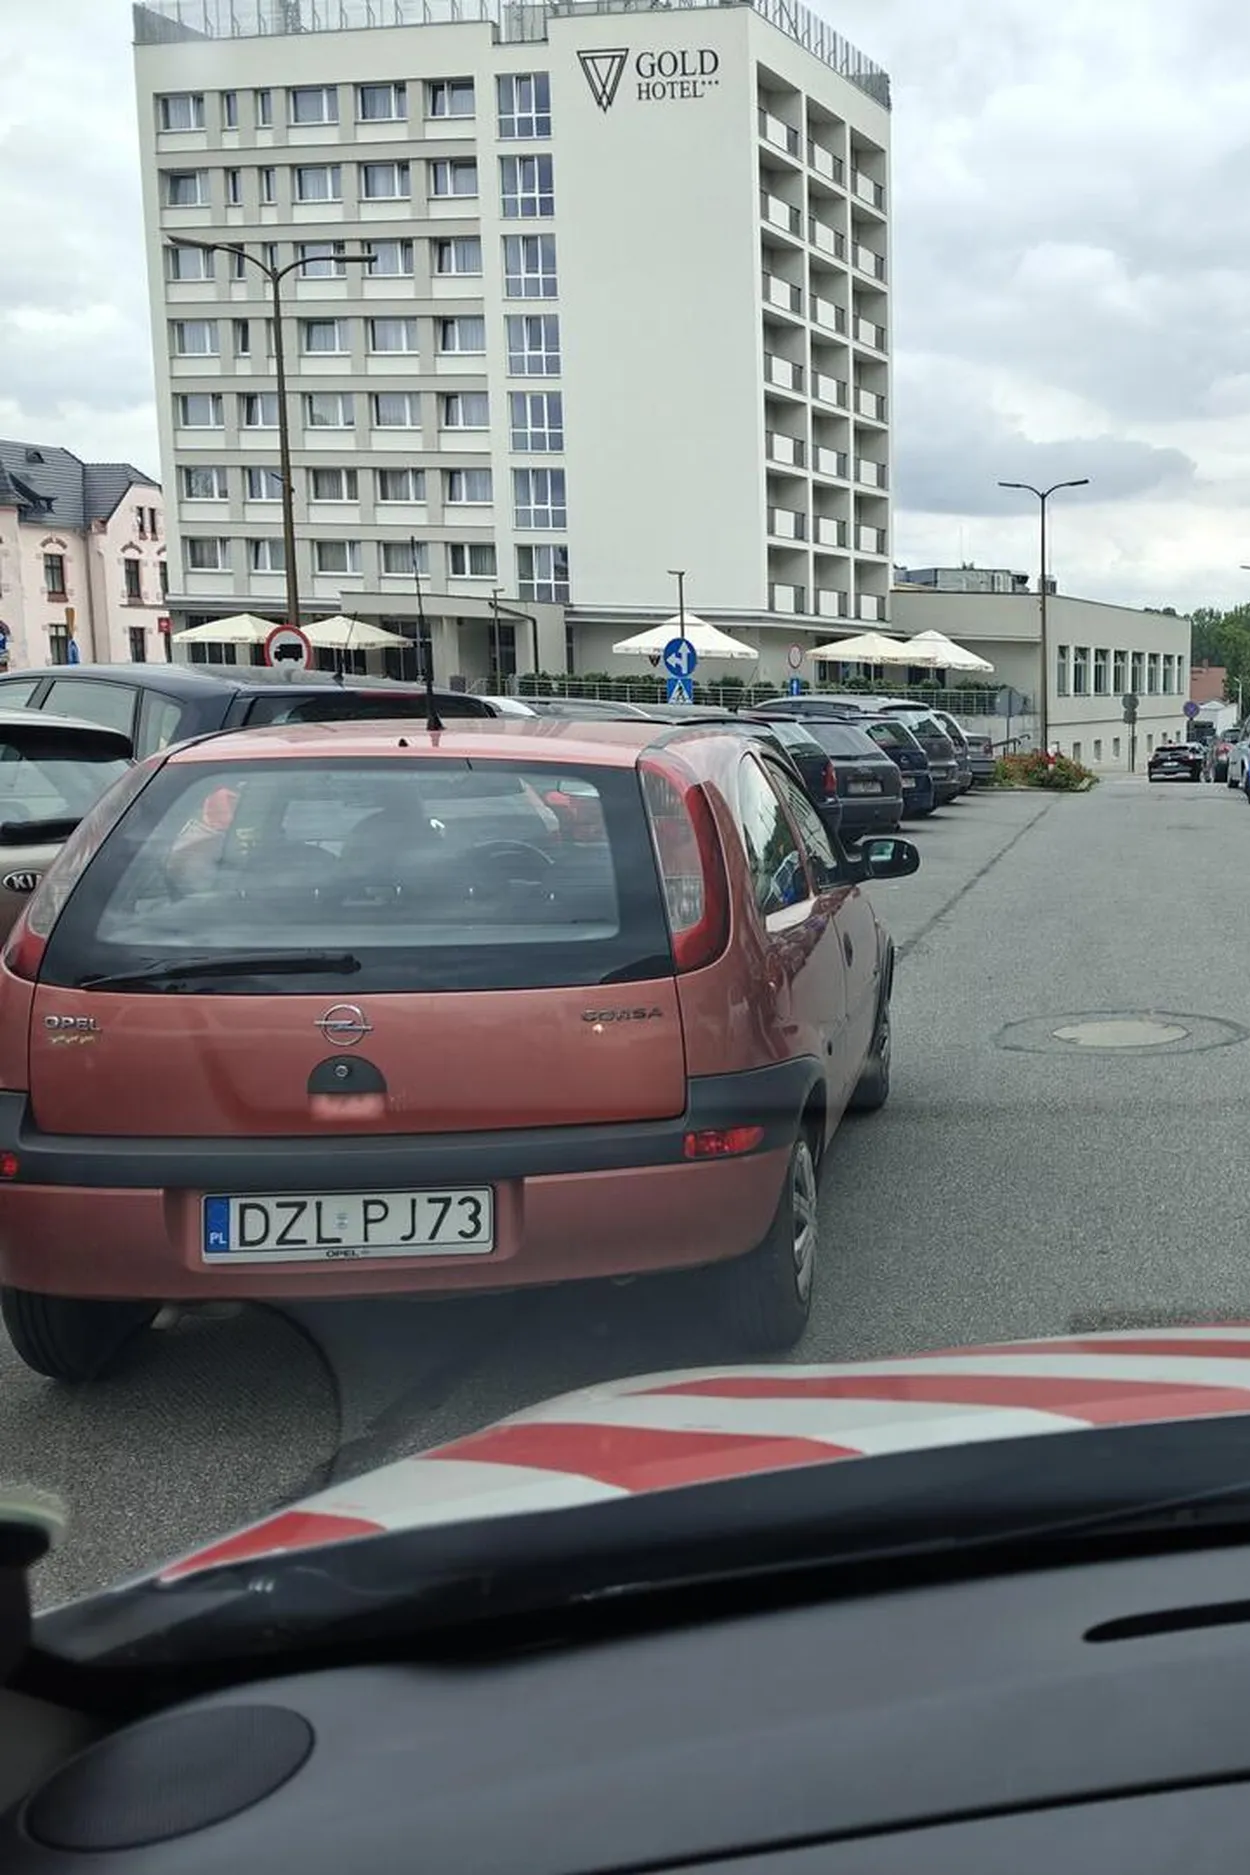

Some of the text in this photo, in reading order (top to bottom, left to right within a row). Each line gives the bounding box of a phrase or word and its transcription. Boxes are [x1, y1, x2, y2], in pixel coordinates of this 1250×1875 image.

[636, 49, 719, 78] GOLD
[582, 1008, 663, 1022] CORSA
[44, 1015, 101, 1031] OPEL
[238, 1196, 483, 1248] DZL PJ73
[209, 1231, 227, 1245] PL
[325, 1250, 360, 1259] OPEL
